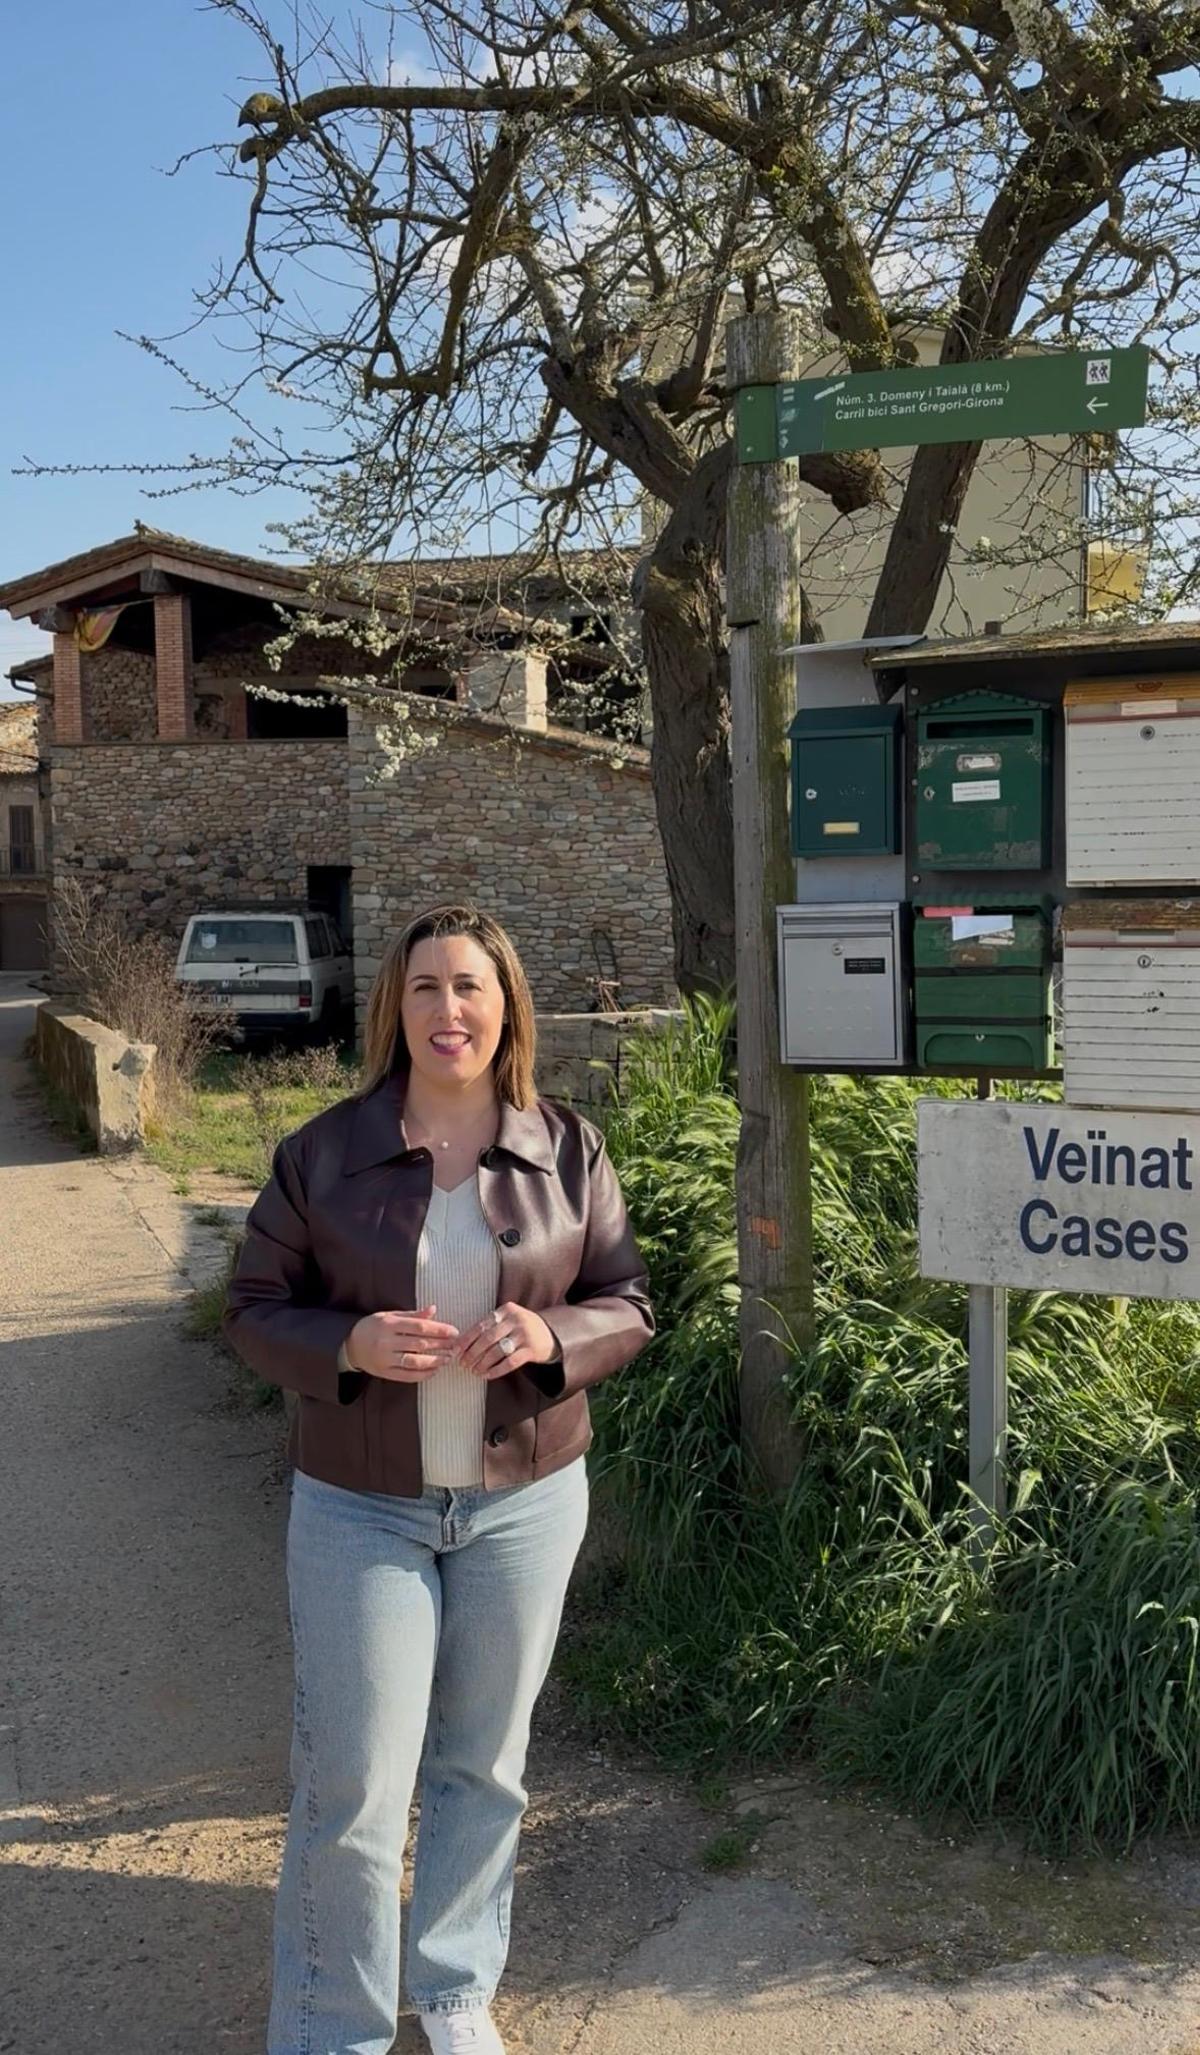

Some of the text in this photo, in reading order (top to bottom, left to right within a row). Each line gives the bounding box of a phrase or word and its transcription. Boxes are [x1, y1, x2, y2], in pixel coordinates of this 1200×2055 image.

[835, 397, 1004, 420] Carril bici Sant Gregori-Girona
[836, 395, 864, 406] Núm.
[867, 393, 876, 403] 3.
[880, 390, 925, 402] Domeny
[936, 384, 968, 397] Taialà
[971, 382, 982, 396] (8
[985, 380, 1010, 393] km.)
[1023, 1126, 1193, 1190] Veïnat
[1020, 1198, 1189, 1264] Cases
